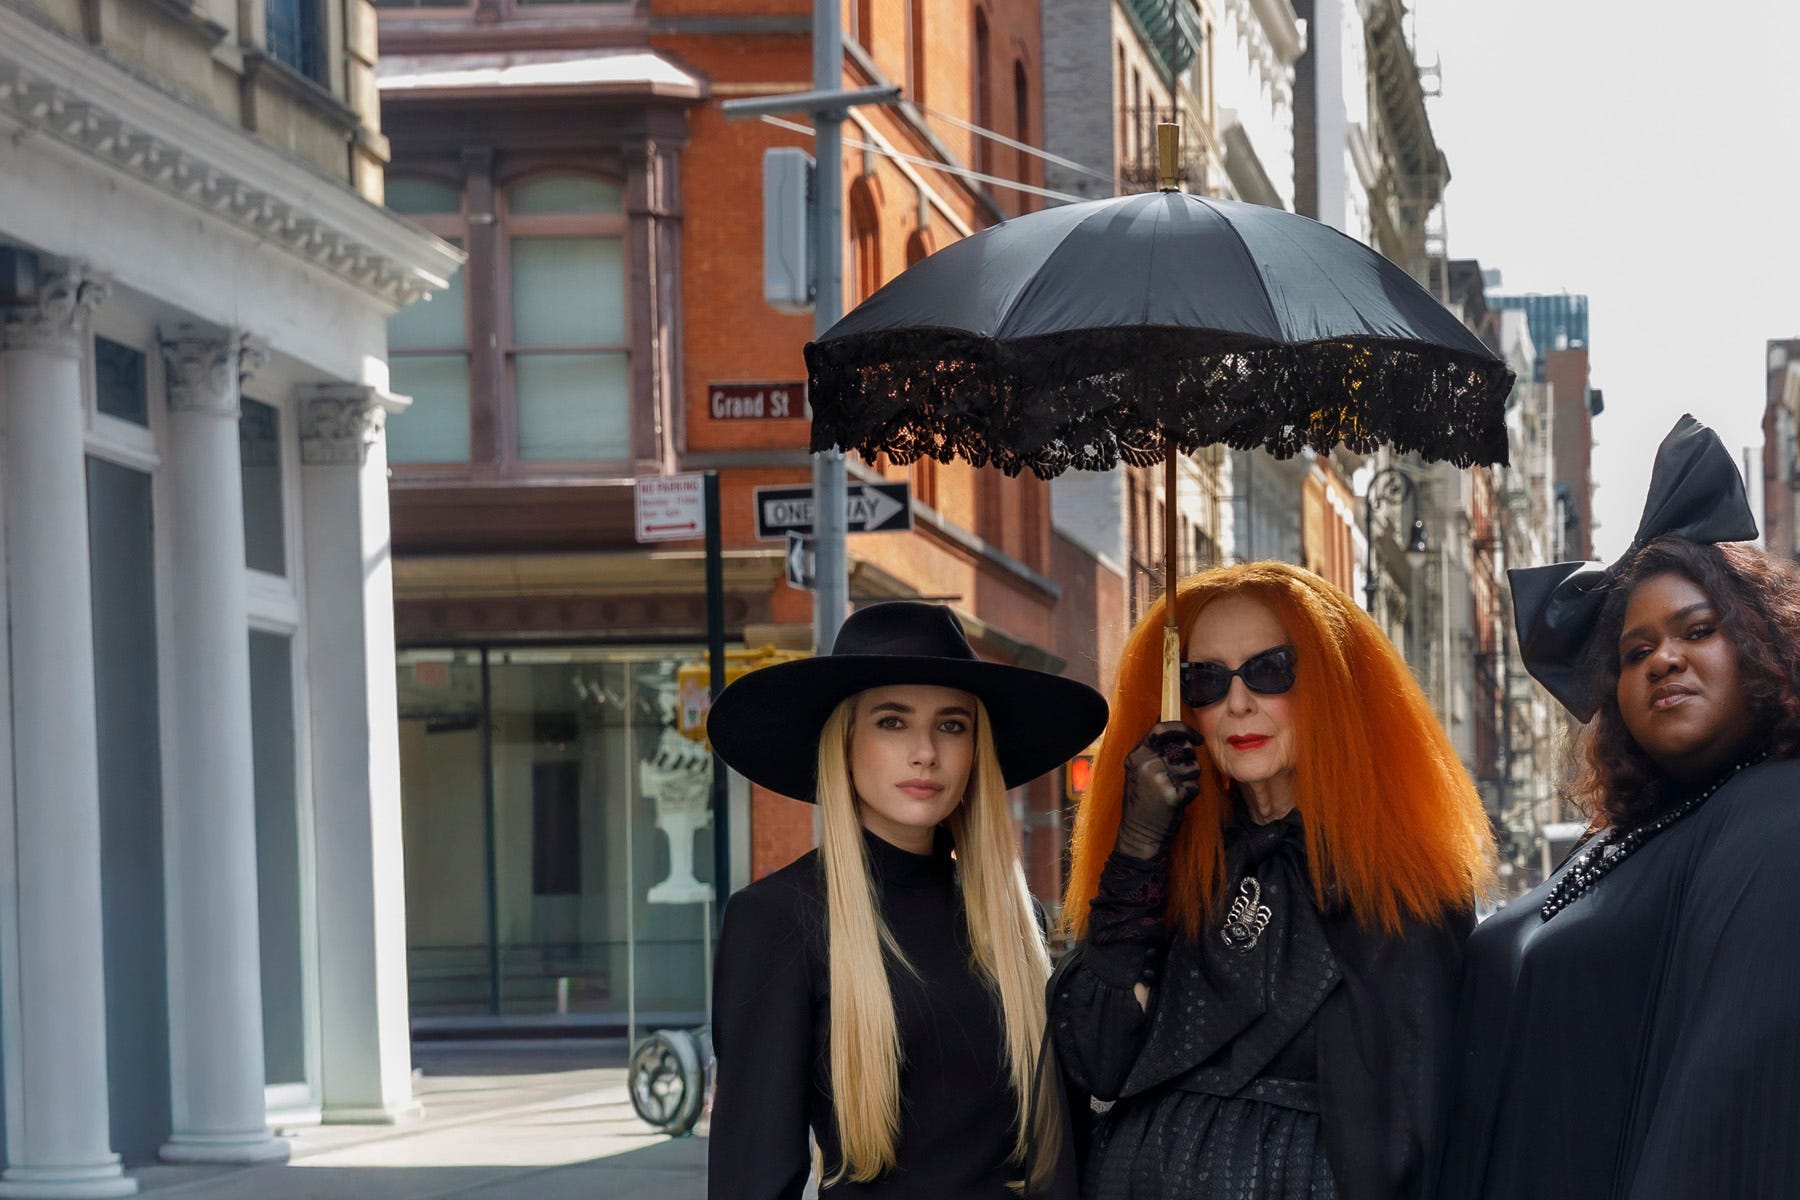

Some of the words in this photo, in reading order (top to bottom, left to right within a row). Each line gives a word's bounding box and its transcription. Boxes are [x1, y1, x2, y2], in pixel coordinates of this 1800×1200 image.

[712, 391, 764, 418] Grand
[770, 390, 790, 417] St
[847, 498, 880, 520] AY
